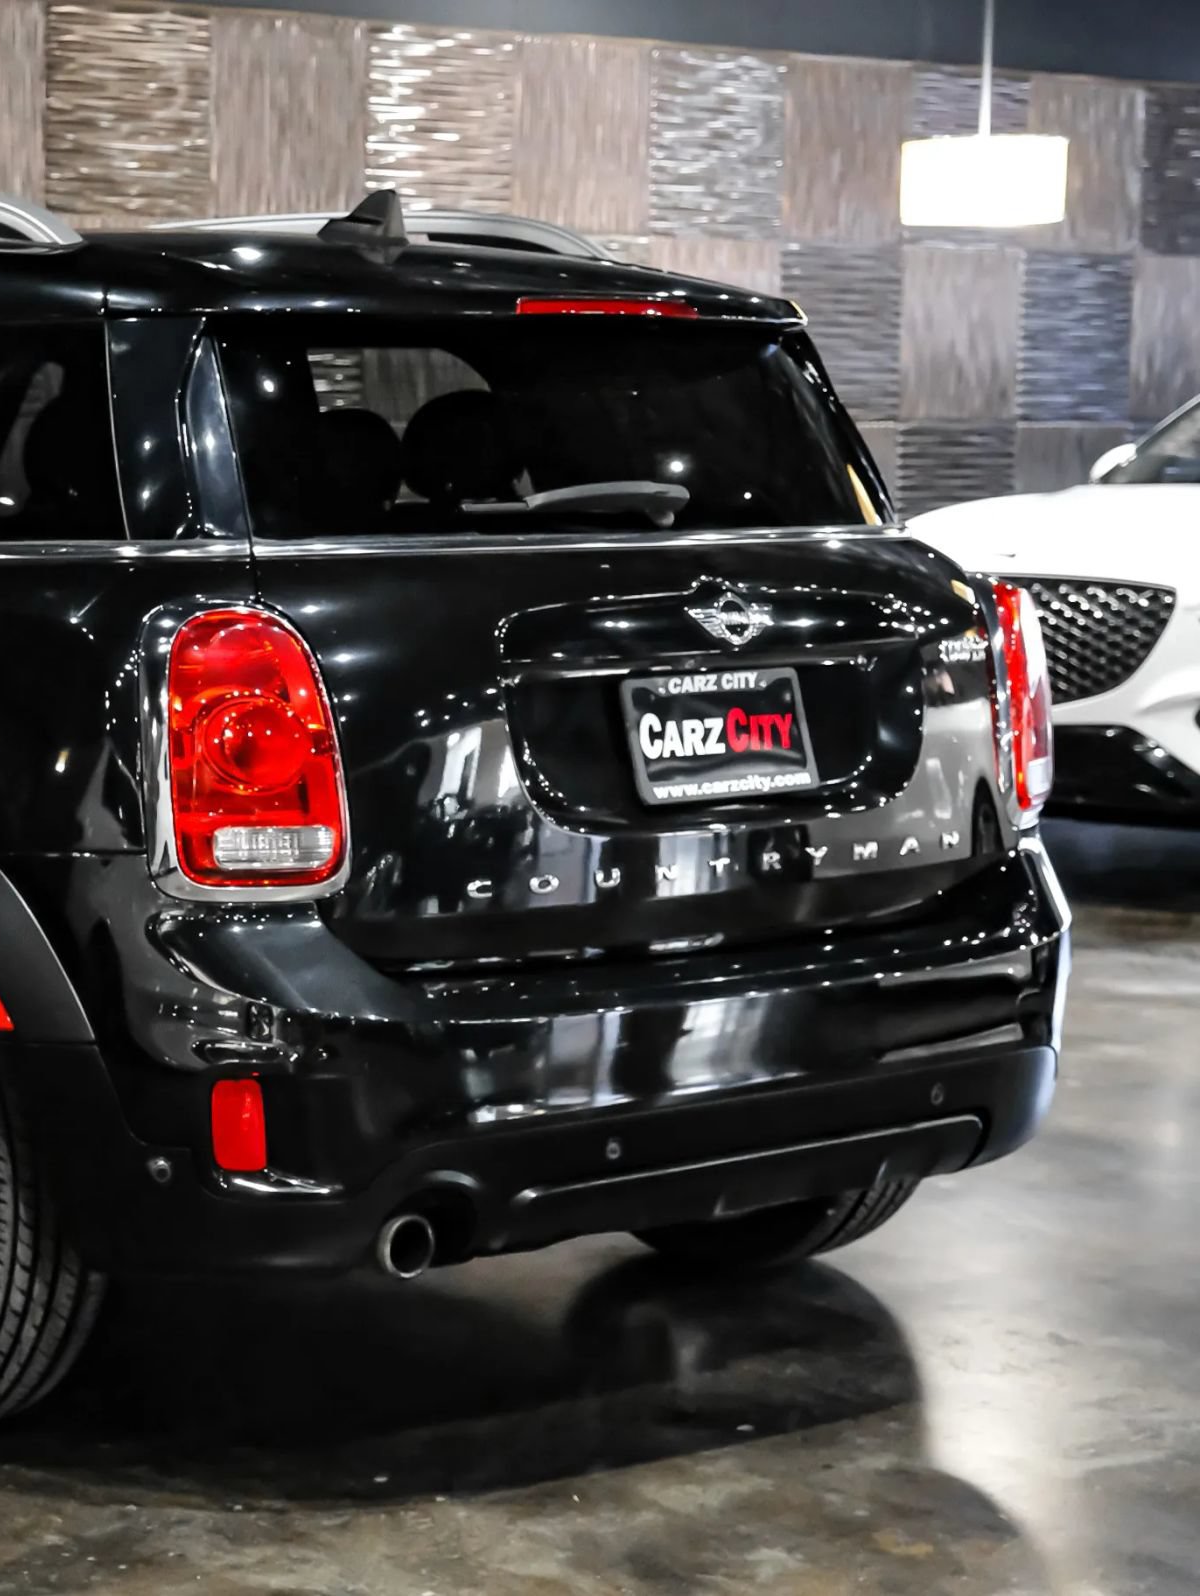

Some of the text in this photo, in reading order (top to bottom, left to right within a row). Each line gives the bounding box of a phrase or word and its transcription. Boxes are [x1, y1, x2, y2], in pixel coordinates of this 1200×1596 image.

[668, 672, 758, 694] CARZ CITY
[653, 772, 811, 799] www.carzcity.com
[467, 831, 960, 898] COUNTRYMAN
